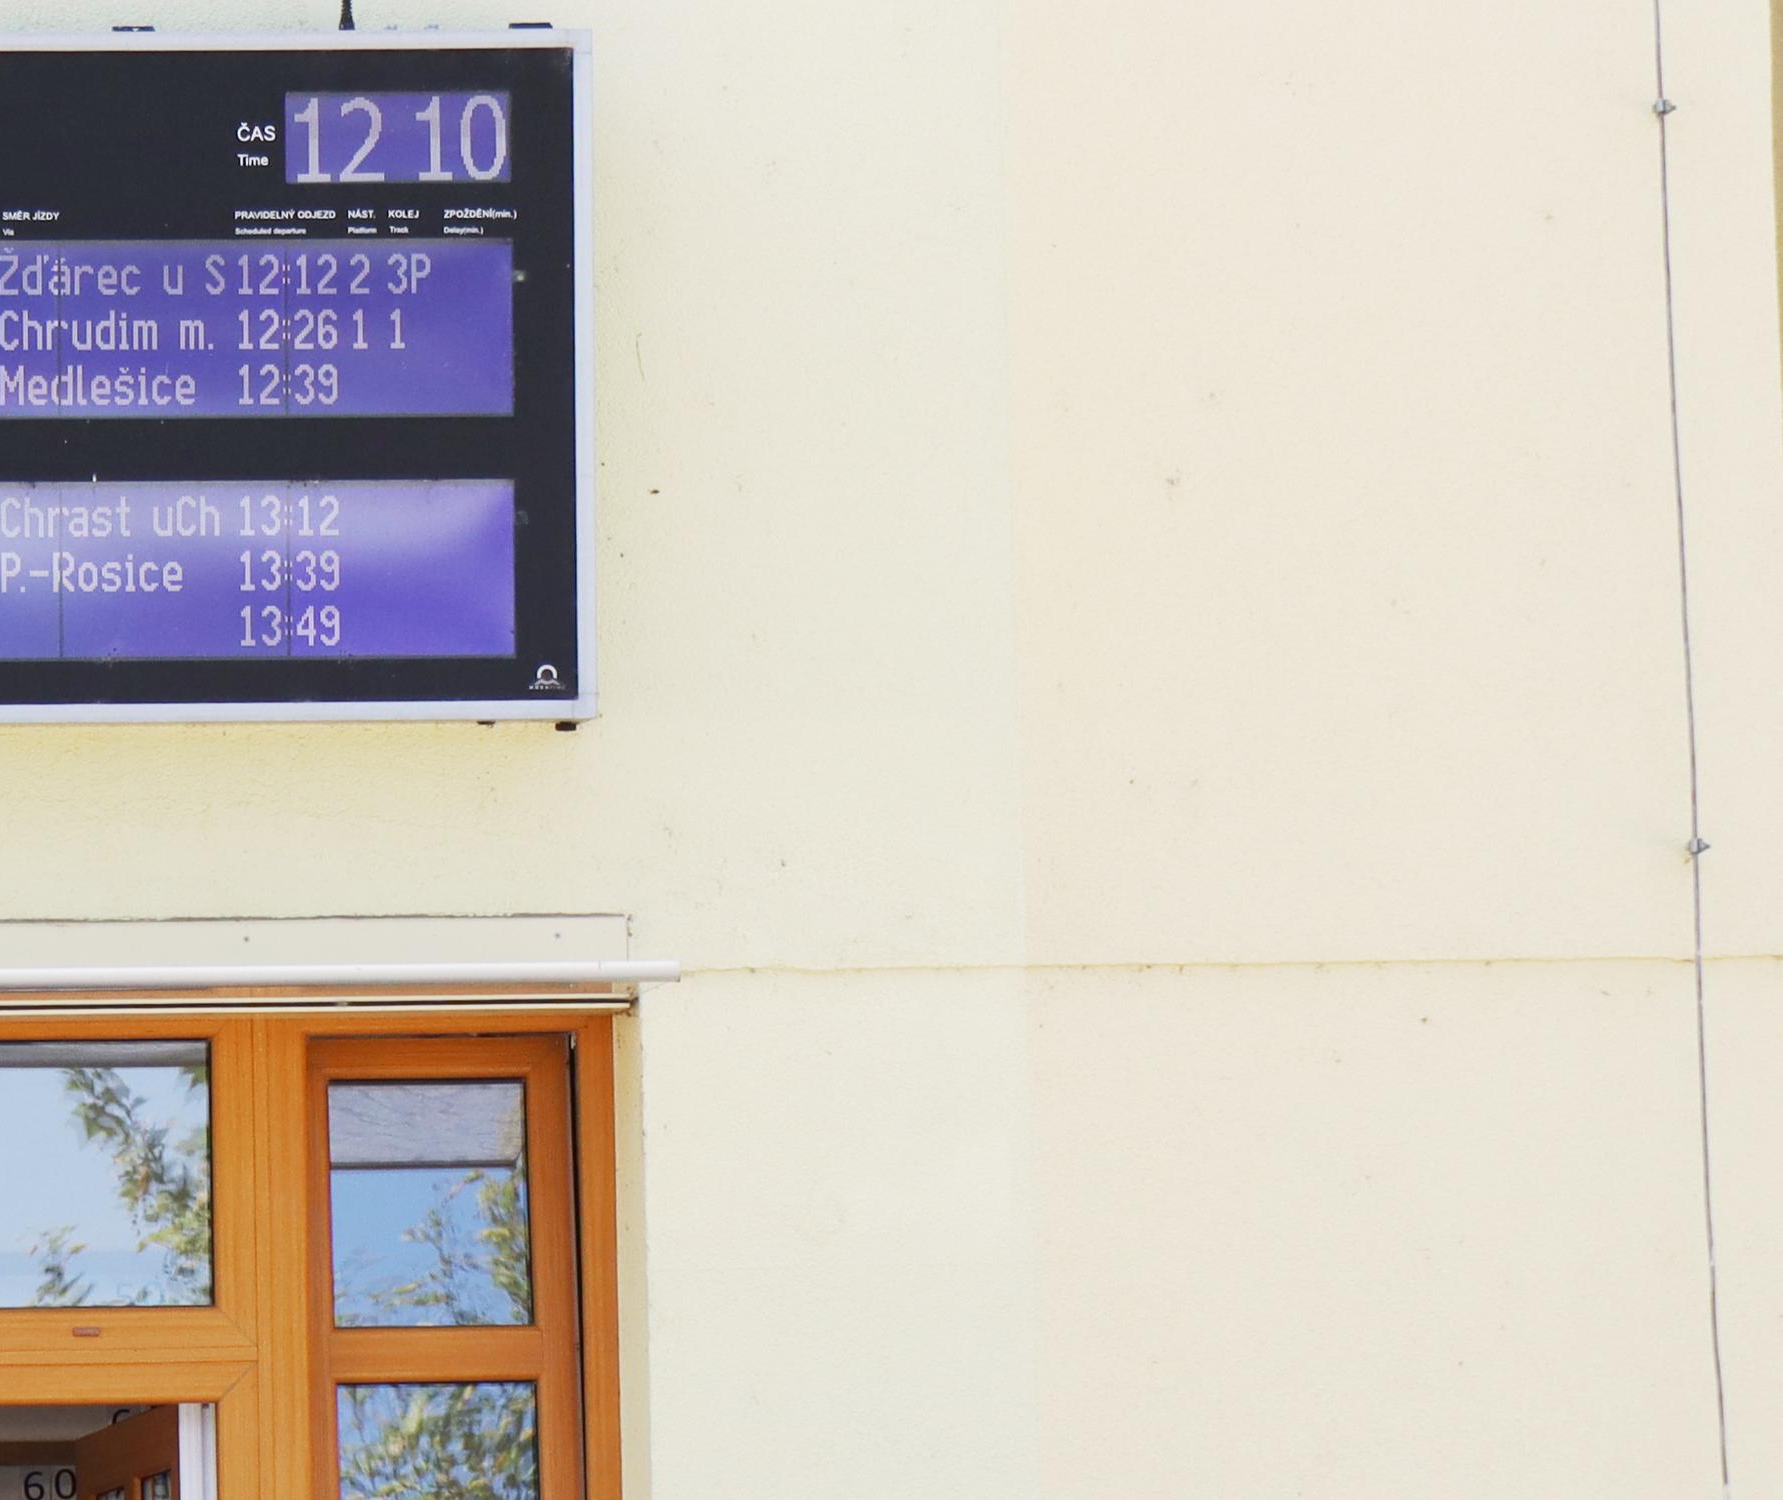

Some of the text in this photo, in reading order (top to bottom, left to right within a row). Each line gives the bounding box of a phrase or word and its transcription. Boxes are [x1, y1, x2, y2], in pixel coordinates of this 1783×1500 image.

[237, 124, 276, 143] ČAS
[294, 95, 508, 183] 12 10
[237, 153, 269, 167] Time
[2, 210, 31, 221] SMĚR
[234, 209, 336, 220] PRAVIDELNÝ ODJEZD
[347, 208, 376, 220] NÁST.
[388, 209, 420, 220] KOLEJ
[389, 225, 409, 234] Track
[163, 264, 184, 297] u
[349, 254, 371, 295] 2
[388, 254, 431, 295] 3P
[180, 317, 216, 351] m.
[238, 309, 339, 351] 12:26
[350, 310, 369, 350] 1
[389, 310, 407, 350] 1
[238, 365, 339, 406] 12:39
[0, 496, 131, 539] Chrast
[152, 496, 221, 539] uCh
[239, 495, 341, 537] 13:12
[0, 551, 184, 594] P.-Rosice
[239, 550, 341, 593] 13:39
[239, 605, 341, 648] 13:49
